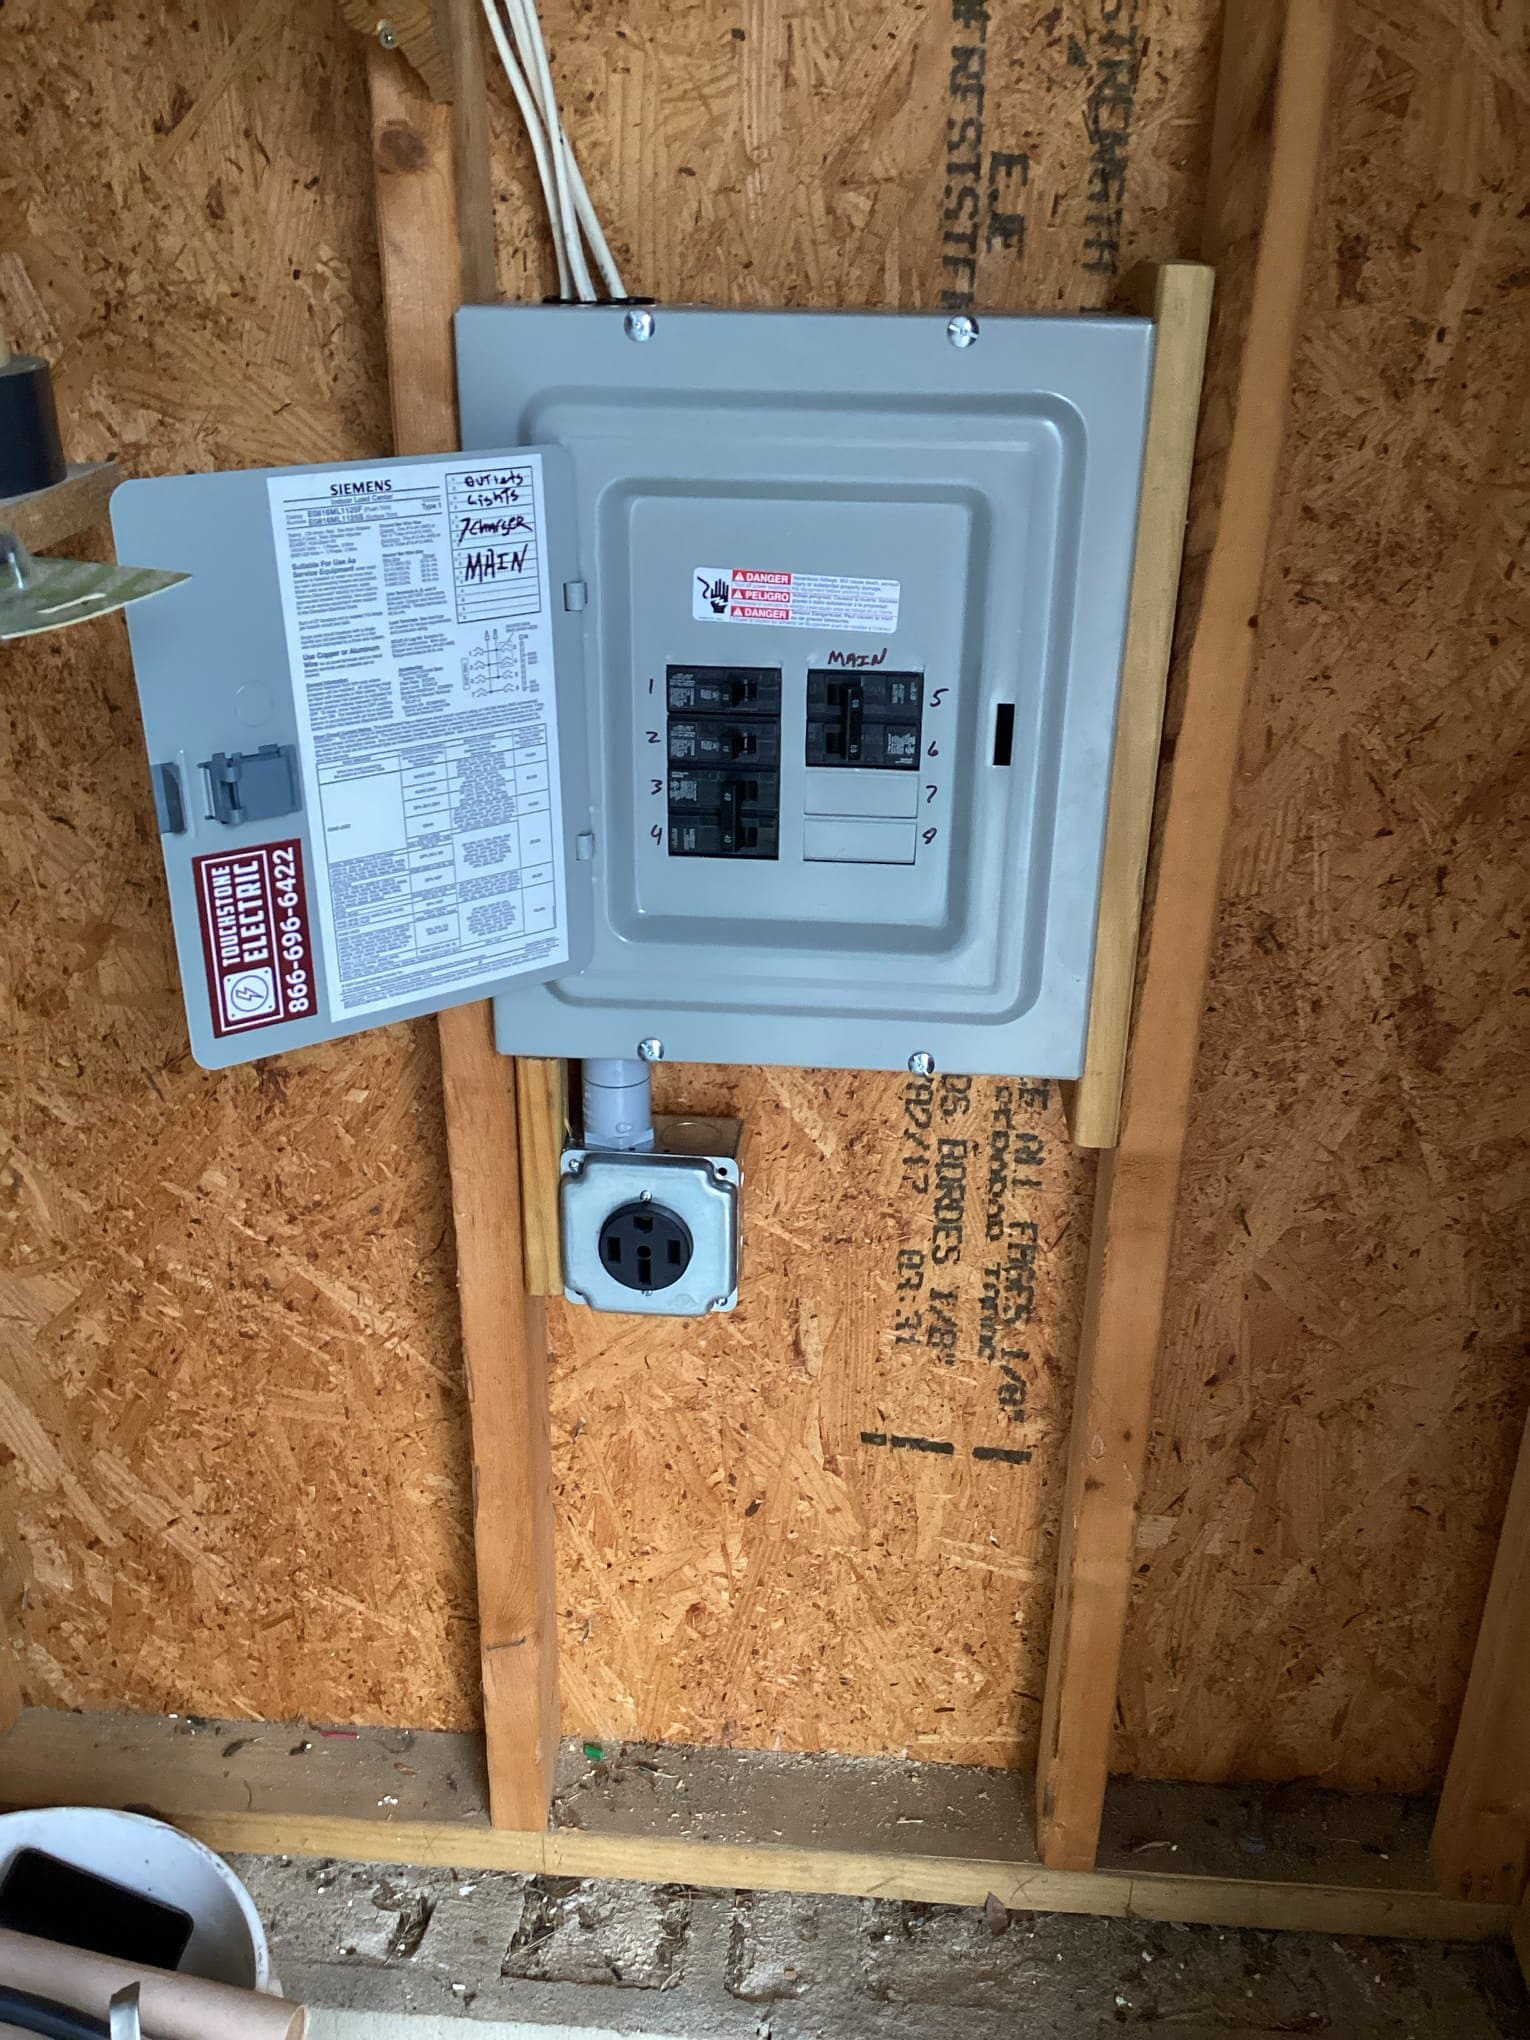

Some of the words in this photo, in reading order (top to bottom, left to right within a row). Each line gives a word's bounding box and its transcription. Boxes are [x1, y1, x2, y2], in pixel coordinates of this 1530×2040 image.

[329, 479, 392, 496] SIEMENS
[465, 543, 529, 583] MAIN
[746, 573, 789, 584] DANGER
[745, 590, 789, 602] PELIGRO
[744, 608, 787, 619] DANGER
[827, 648, 888, 668] MAIN
[648, 678, 654, 695] 1
[929, 688, 949, 707] 5
[646, 731, 661, 744] 2
[927, 741, 939, 757] 6
[650, 779, 663, 795] 3
[926, 785, 938, 803] 7
[650, 824, 663, 846] 4
[211, 865, 241, 967] TOUCHSTONE
[233, 860, 269, 963] ELECTRIC
[272, 846, 310, 1013] 866-696-6422
[931, 1137, 968, 1264] BORDES
[926, 1287, 958, 1366] 1/8"
